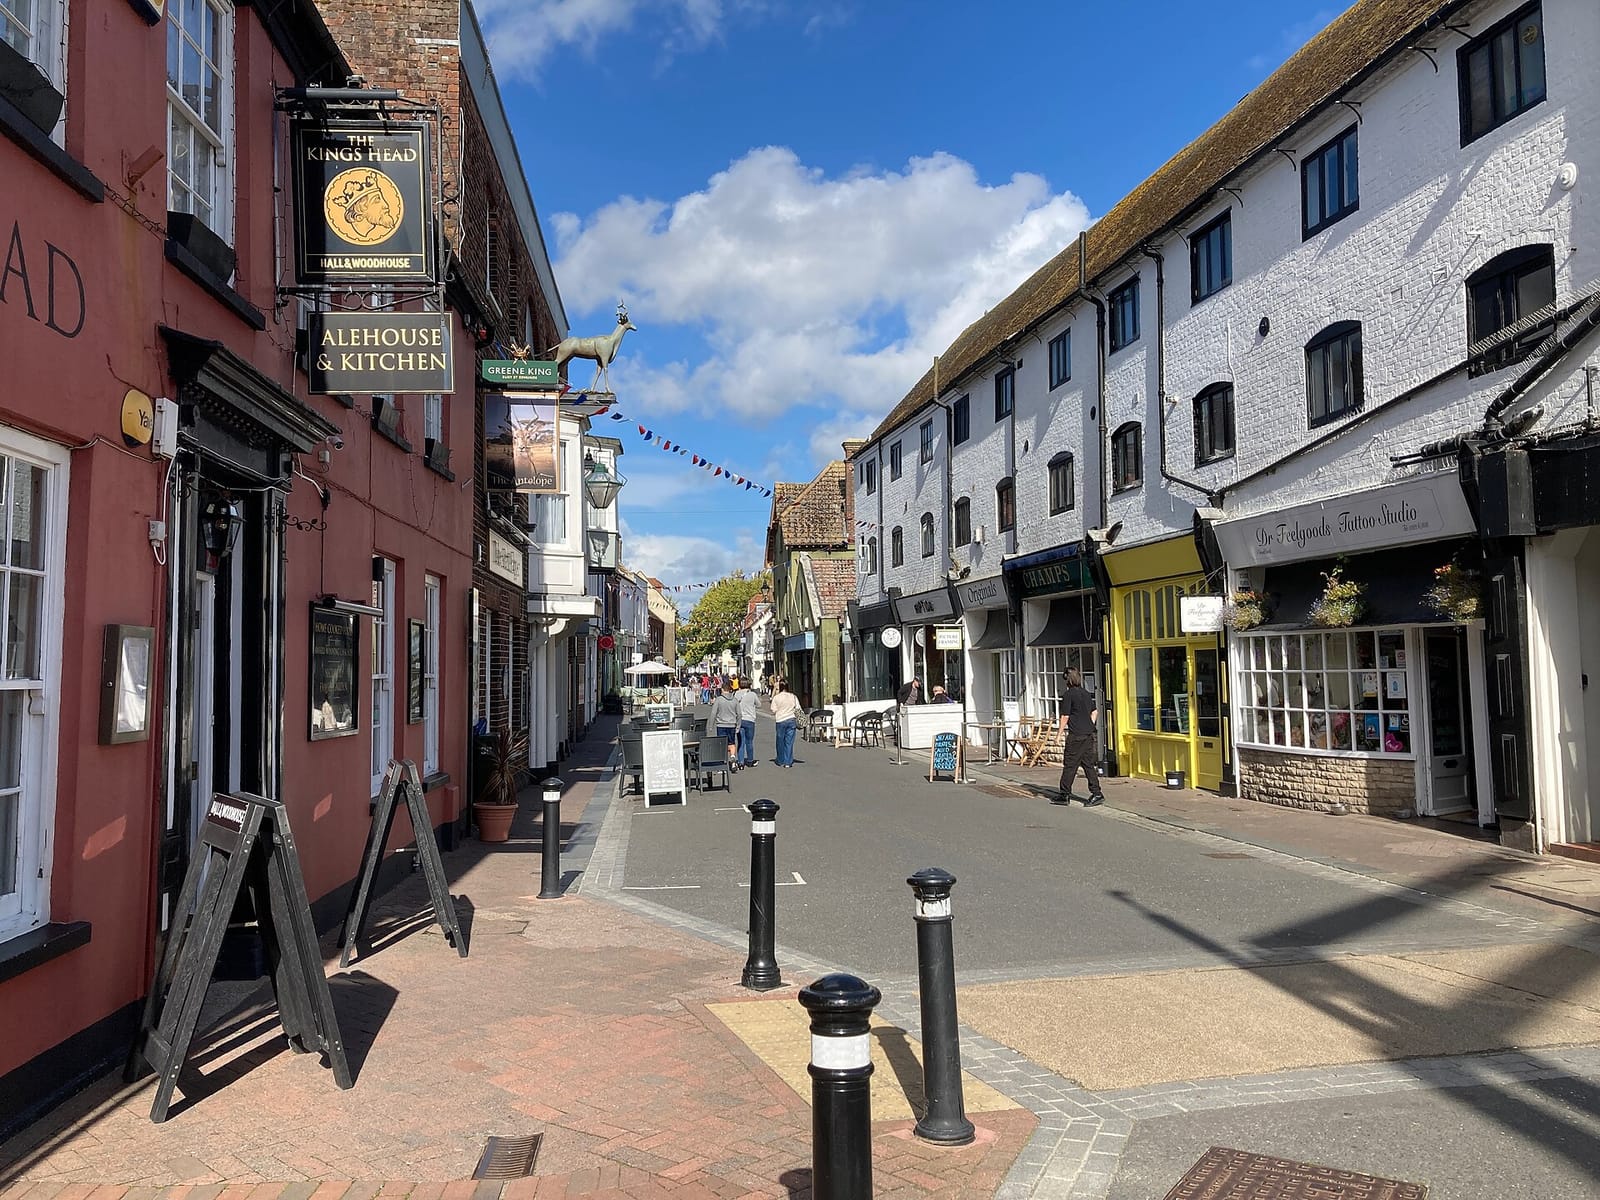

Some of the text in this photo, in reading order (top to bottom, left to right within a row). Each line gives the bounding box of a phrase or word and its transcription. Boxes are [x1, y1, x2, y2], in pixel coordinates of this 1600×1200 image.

[346, 135, 375, 147] THE
[307, 147, 417, 162] KINGS HEAD
[321, 328, 442, 346] ALEHOUSE
[316, 353, 447, 371] & KITCHEN
[487, 366, 552, 376] GREENE KING
[1255, 527, 1274, 547] Dr
[1275, 515, 1331, 548] Feelgoods
[1337, 511, 1376, 533] Tattoo
[1377, 500, 1417, 526] Studio
[1022, 564, 1071, 588] CHAMPS
[967, 580, 998, 605] Originals
